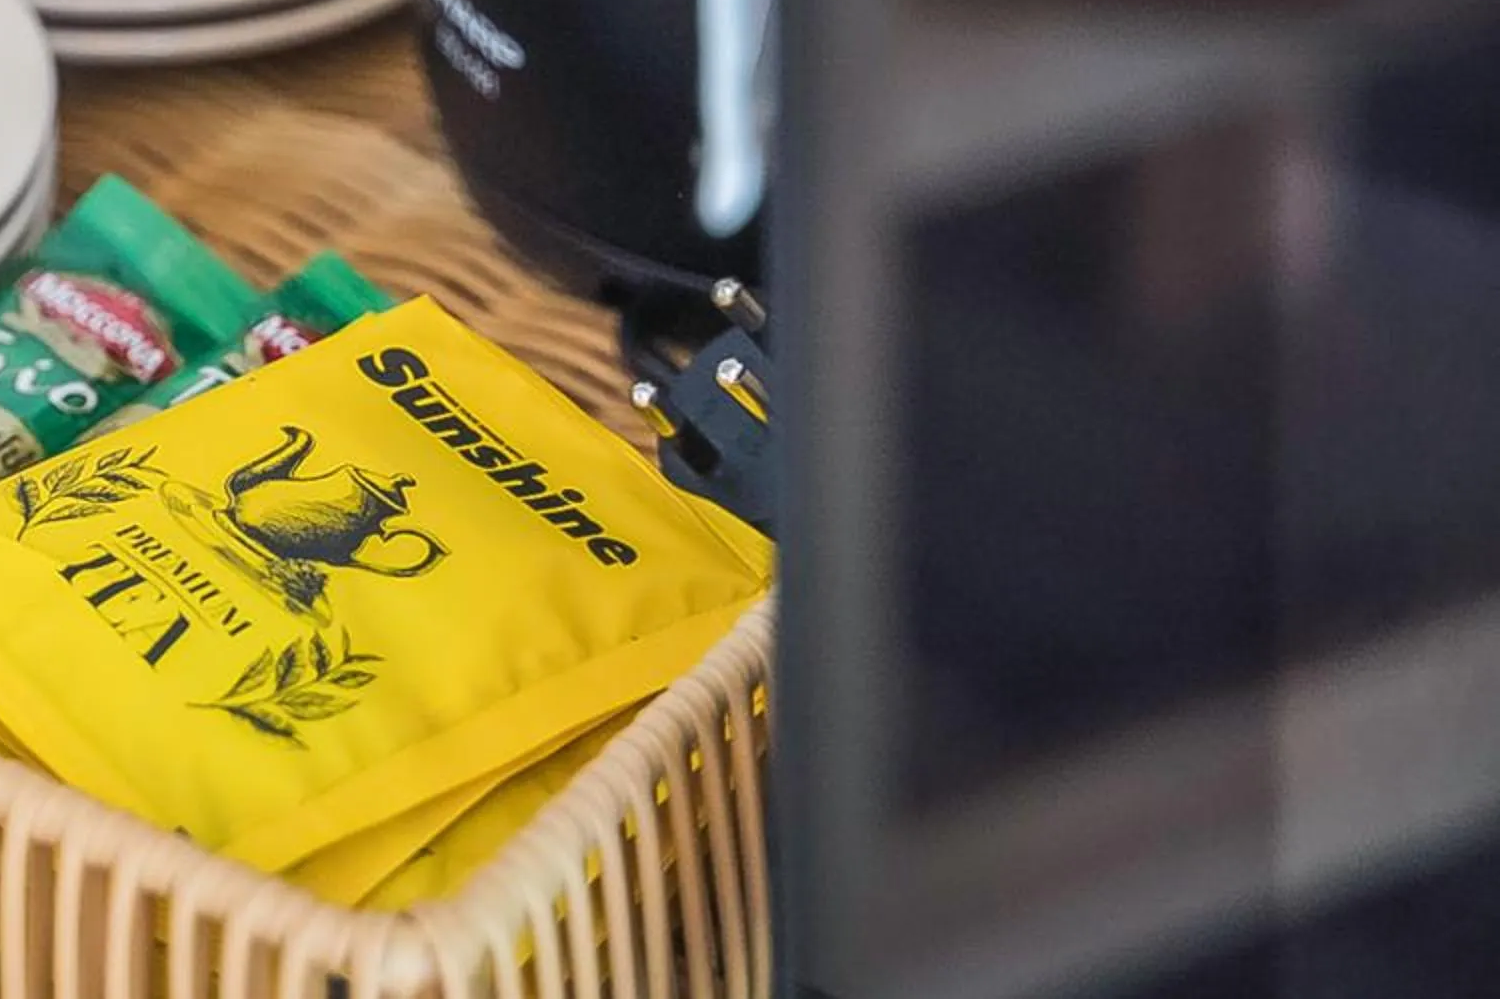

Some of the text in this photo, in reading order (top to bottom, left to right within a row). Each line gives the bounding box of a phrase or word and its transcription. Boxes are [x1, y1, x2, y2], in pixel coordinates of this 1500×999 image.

[357, 347, 639, 567] Sunshine
[58, 542, 194, 669] TEA
[113, 522, 253, 639] PREMIUM
